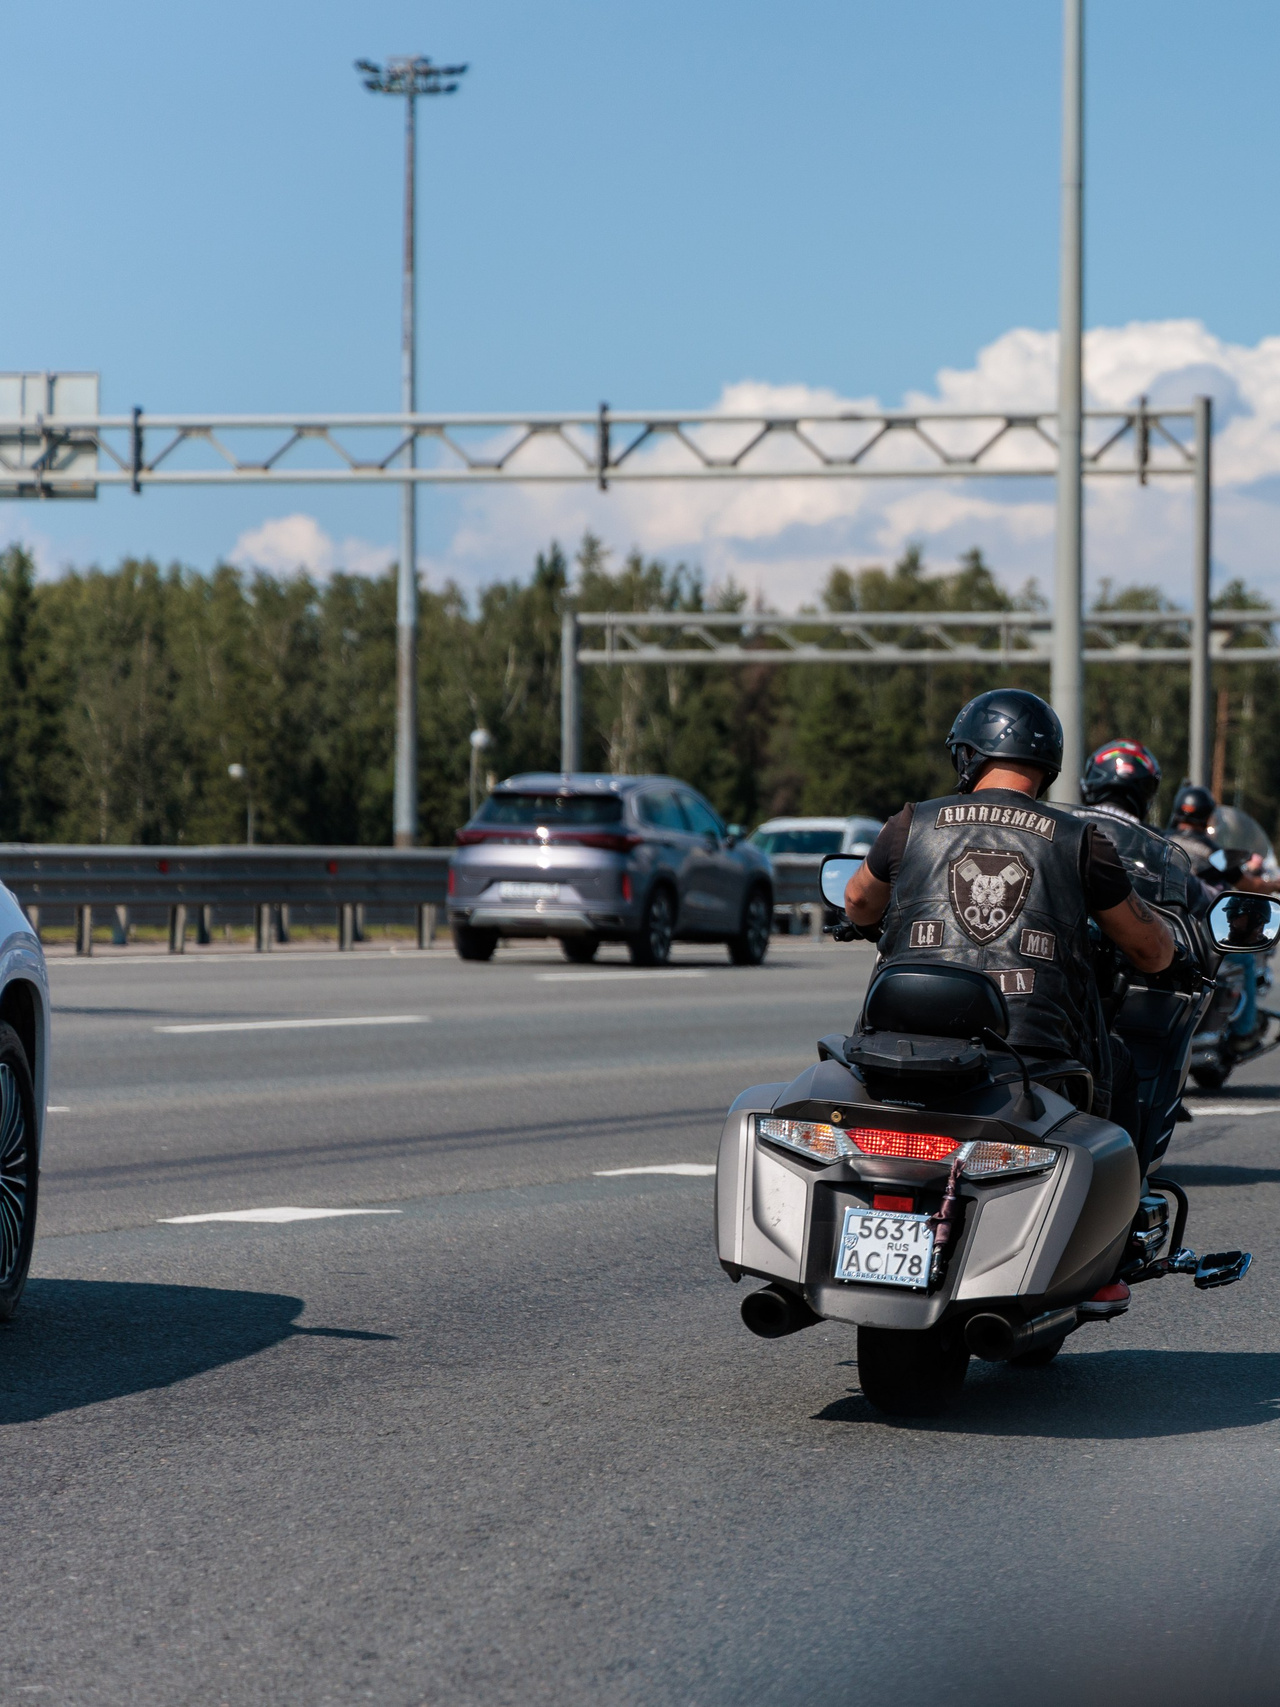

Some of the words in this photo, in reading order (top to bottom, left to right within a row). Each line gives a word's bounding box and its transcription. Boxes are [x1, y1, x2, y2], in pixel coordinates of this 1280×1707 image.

[944, 805, 1051, 833] GUARDSMEN
[917, 923, 935, 945] LE
[1026, 933, 1049, 956] MC
[858, 1216, 920, 1243] 5631
[886, 1242, 909, 1252] RUS
[843, 1250, 882, 1273] AC
[893, 1253, 922, 1276] 78
